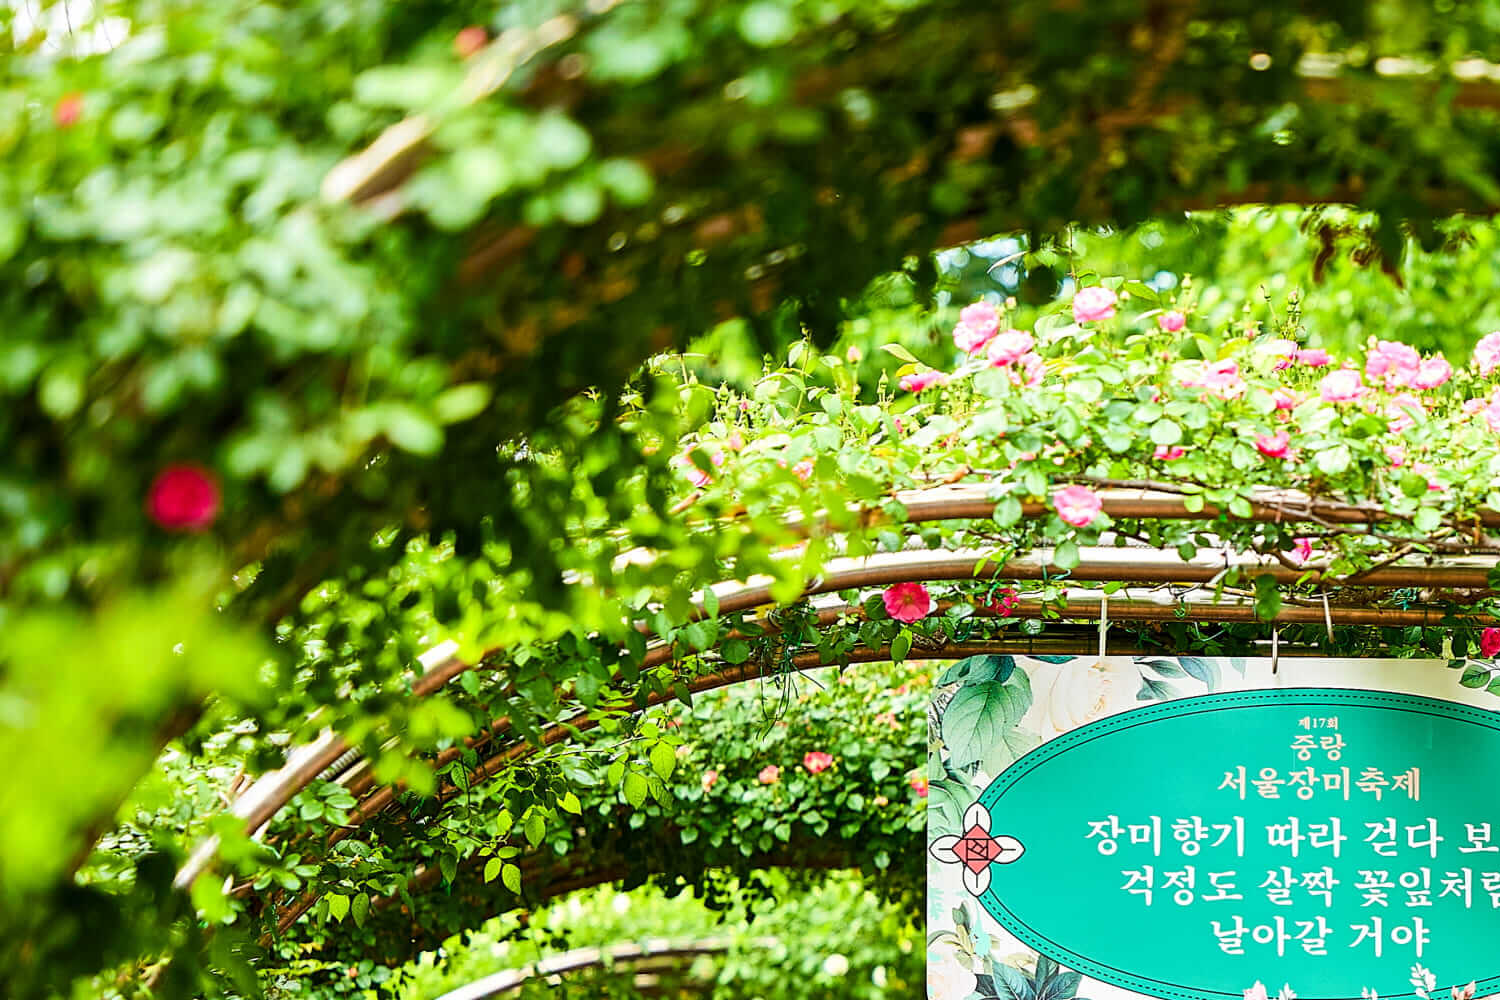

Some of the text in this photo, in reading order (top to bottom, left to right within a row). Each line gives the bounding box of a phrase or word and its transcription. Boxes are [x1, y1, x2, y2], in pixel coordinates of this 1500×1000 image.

[1298, 716, 1339, 731] 제17회
[1290, 733, 1346, 761] 중랑
[1218, 766, 1420, 801] 서울장미축제
[1085, 815, 1244, 856] 장미향기
[1265, 816, 1347, 858] 따라
[1364, 817, 1444, 858] 걷다
[1120, 865, 1243, 906] 걱정도
[1258, 866, 1340, 907] 살짝
[1210, 915, 1430, 958] 날아갈 거야
